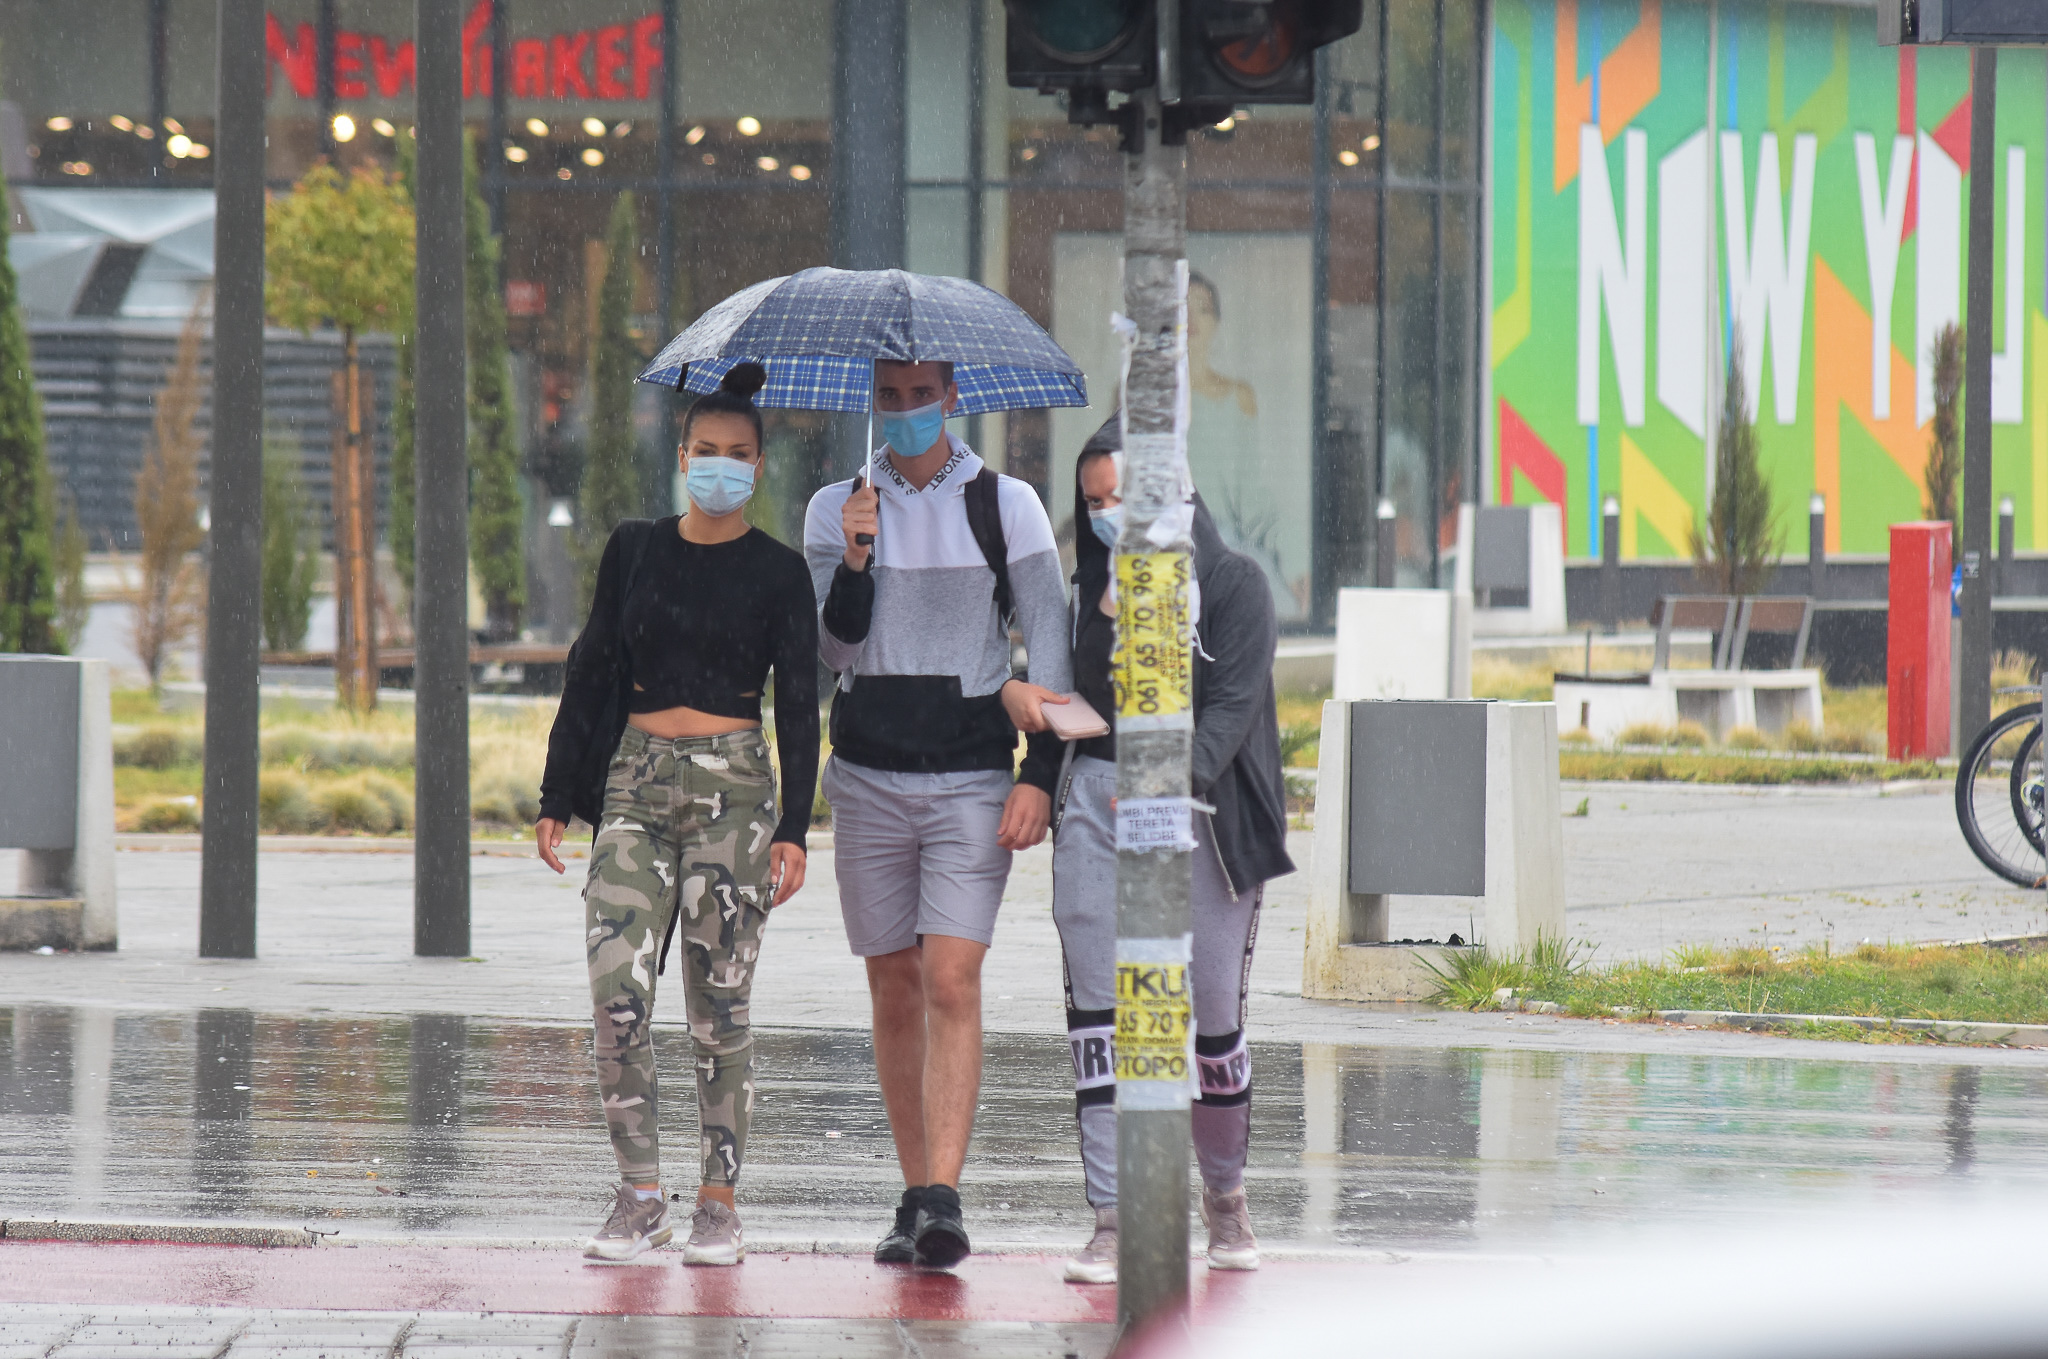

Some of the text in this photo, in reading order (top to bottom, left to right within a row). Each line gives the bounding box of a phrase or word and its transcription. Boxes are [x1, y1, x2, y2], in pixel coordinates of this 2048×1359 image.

[1577, 123, 1818, 441] NOW
[1131, 558, 1160, 714] 061 65 70 969
[1128, 818, 1175, 830] TERETA
[1120, 1010, 1138, 1034] 65
[1147, 1011, 1172, 1035] 70
